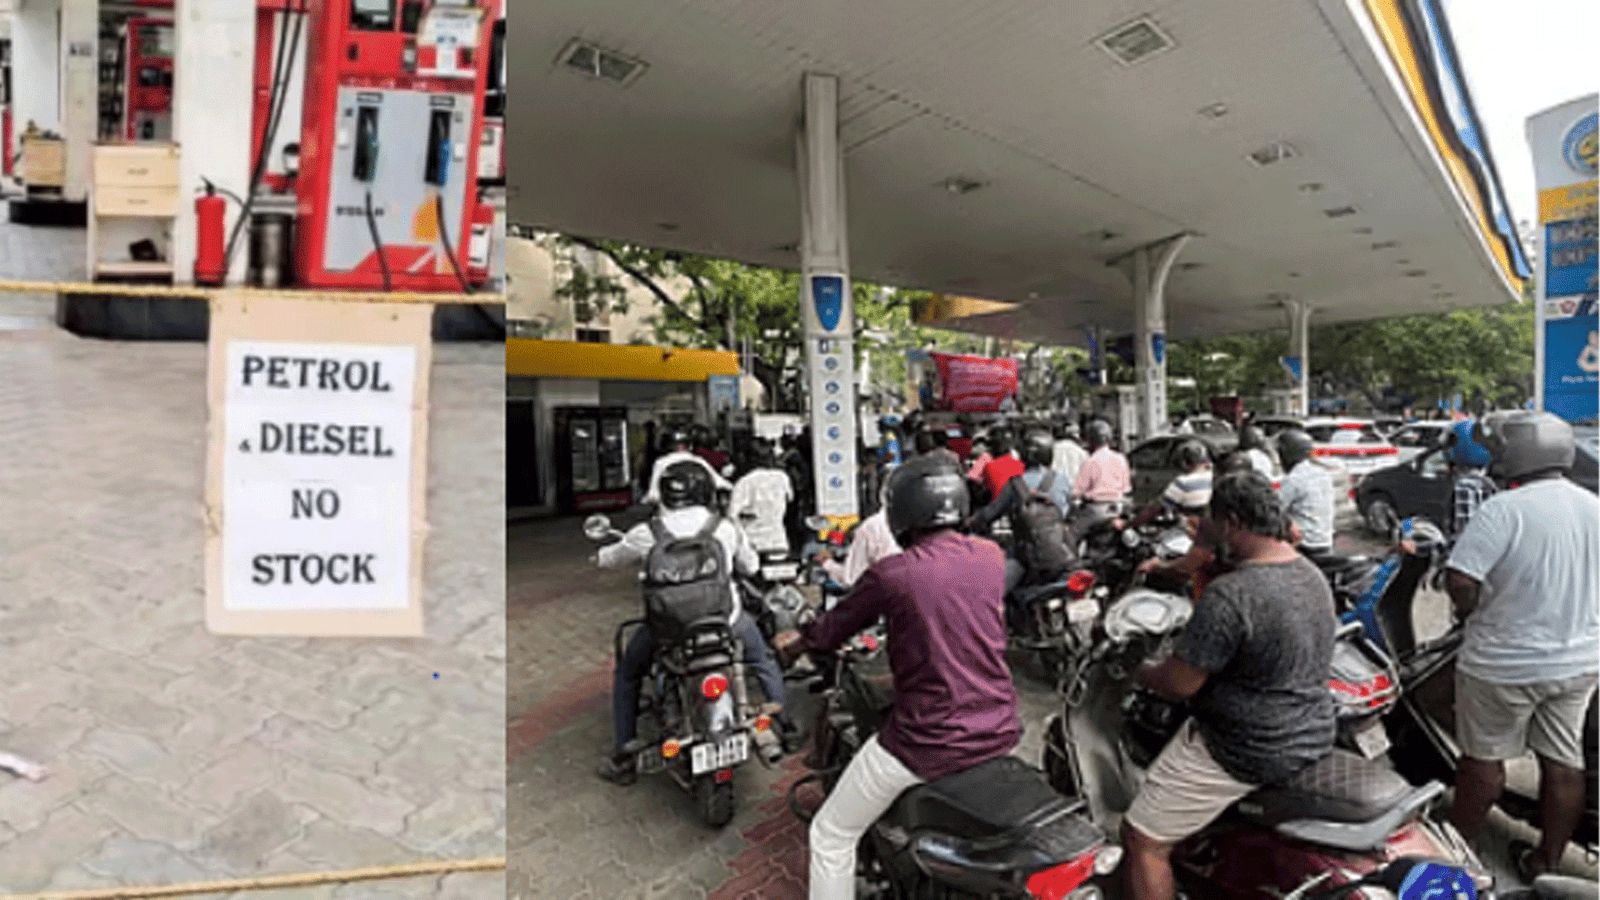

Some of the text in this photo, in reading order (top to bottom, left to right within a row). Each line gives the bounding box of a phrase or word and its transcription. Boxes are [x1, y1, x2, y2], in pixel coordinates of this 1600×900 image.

[241, 354, 392, 393] PETROL
[260, 421, 394, 458] DIESEL
[291, 488, 341, 520] NO
[251, 553, 376, 586] STOCK
